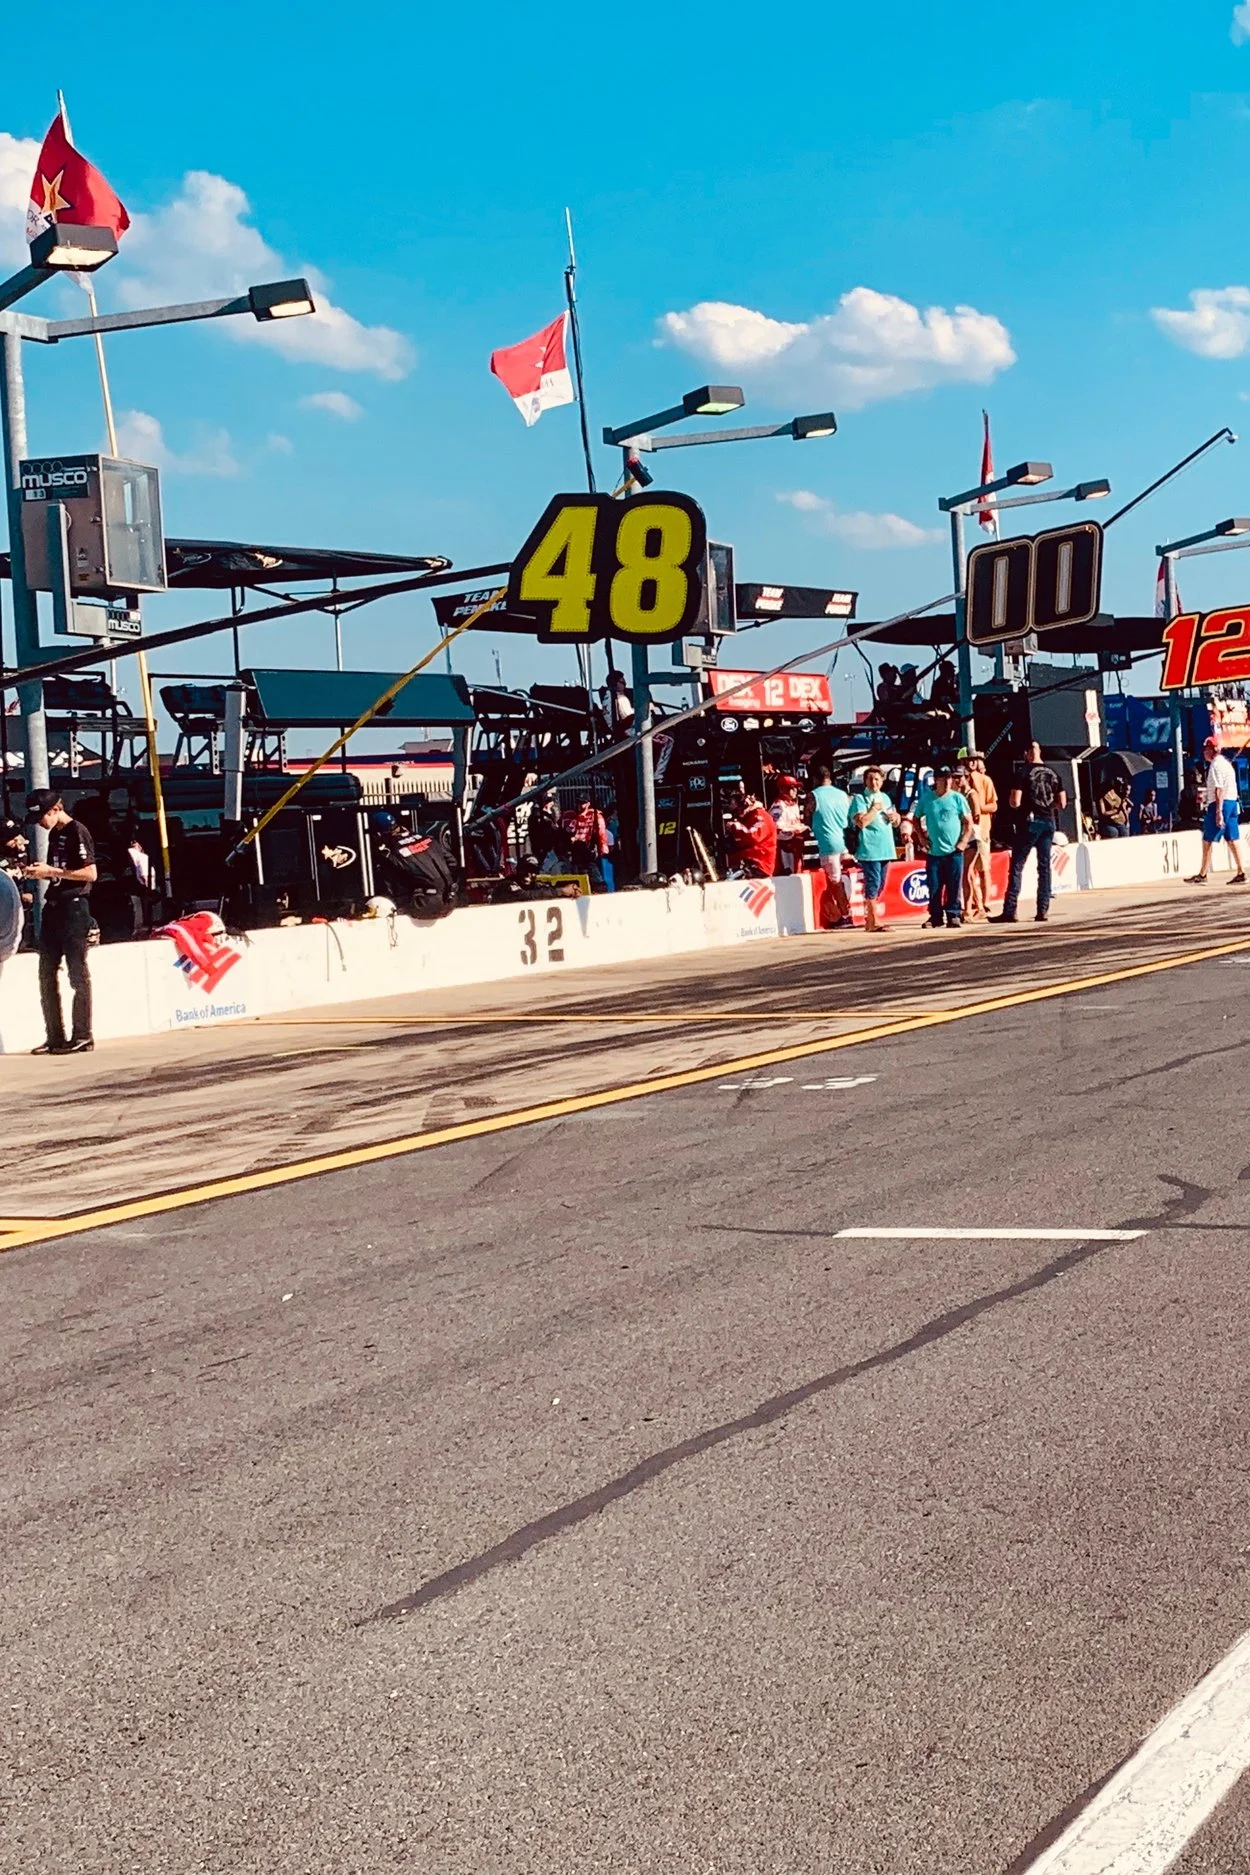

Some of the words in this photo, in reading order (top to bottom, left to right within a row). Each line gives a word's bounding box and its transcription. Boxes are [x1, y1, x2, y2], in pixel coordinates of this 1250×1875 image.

[22, 471, 88, 488] musco
[520, 504, 692, 634] 48
[967, 522, 1102, 646] 00
[108, 618, 141, 633] musco
[764, 679, 784, 706] 12
[1141, 717, 1171, 745] 37
[658, 821, 677, 835] 12
[1162, 839, 1180, 873] 30
[519, 906, 566, 965] 32
[176, 1008, 199, 1022] Bank
[199, 1004, 209, 1019] of
[210, 1002, 247, 1018] America
